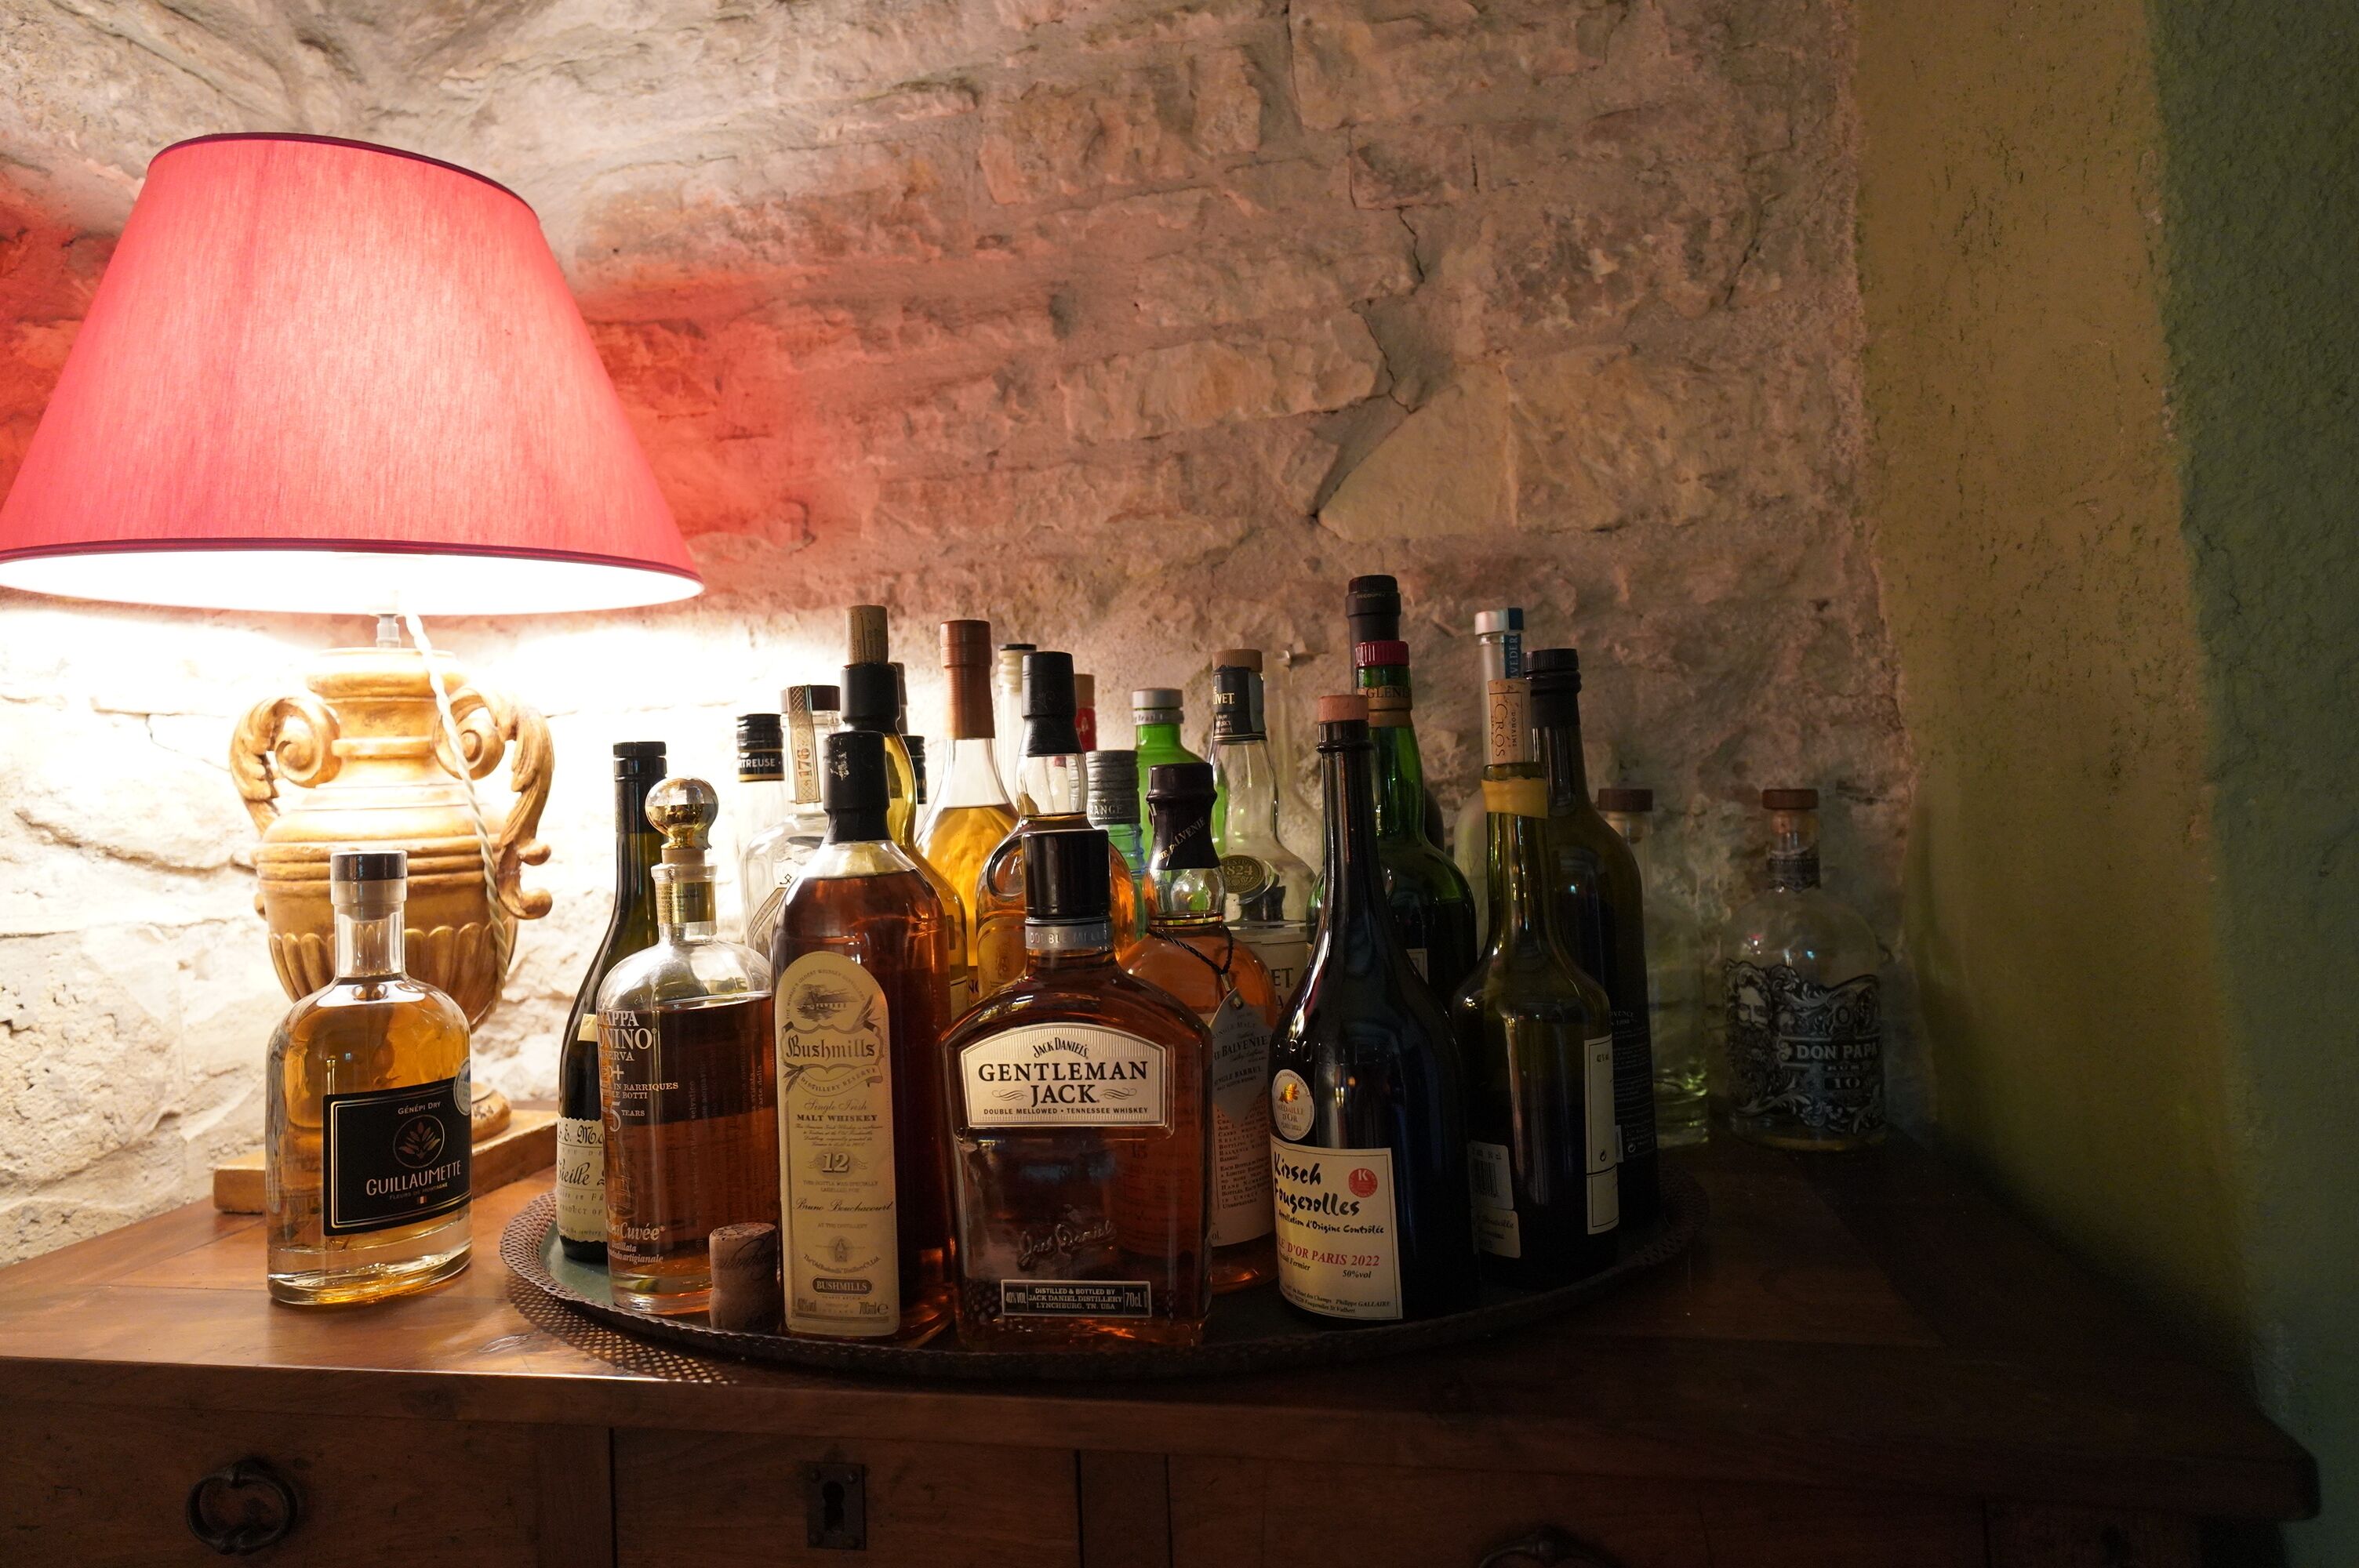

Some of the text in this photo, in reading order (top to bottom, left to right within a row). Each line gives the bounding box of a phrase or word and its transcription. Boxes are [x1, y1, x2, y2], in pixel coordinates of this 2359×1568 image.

[1223, 865, 1253, 876] 824
[786, 1033, 876, 1062] Bushmills
[1033, 1036, 1089, 1058] JACK DANIEL'S
[1797, 1042, 1880, 1060] DON PAPA
[978, 1061, 1148, 1082] GENTLEMAN
[624, 1083, 679, 1092] BARRIQUES
[1030, 1084, 1099, 1107] JACK
[398, 1105, 427, 1115] GÉNÉPI
[821, 1151, 850, 1174] 12
[1274, 1151, 1321, 1185] Kirsch
[365, 1160, 462, 1196] GUILLAUMETTE
[1358, 1169, 1369, 1181] K
[1274, 1178, 1361, 1216] Fougerolles
[1306, 1219, 1341, 1234] d'Origine
[1343, 1223, 1385, 1235] Contrôlée
[1287, 1240, 1309, 1258] D'OR
[1311, 1247, 1347, 1265] PARIS
[1350, 1254, 1381, 1266] 2022
[1289, 1256, 1311, 1271] Fermier
[816, 1280, 868, 1291] BUSHMILLS
